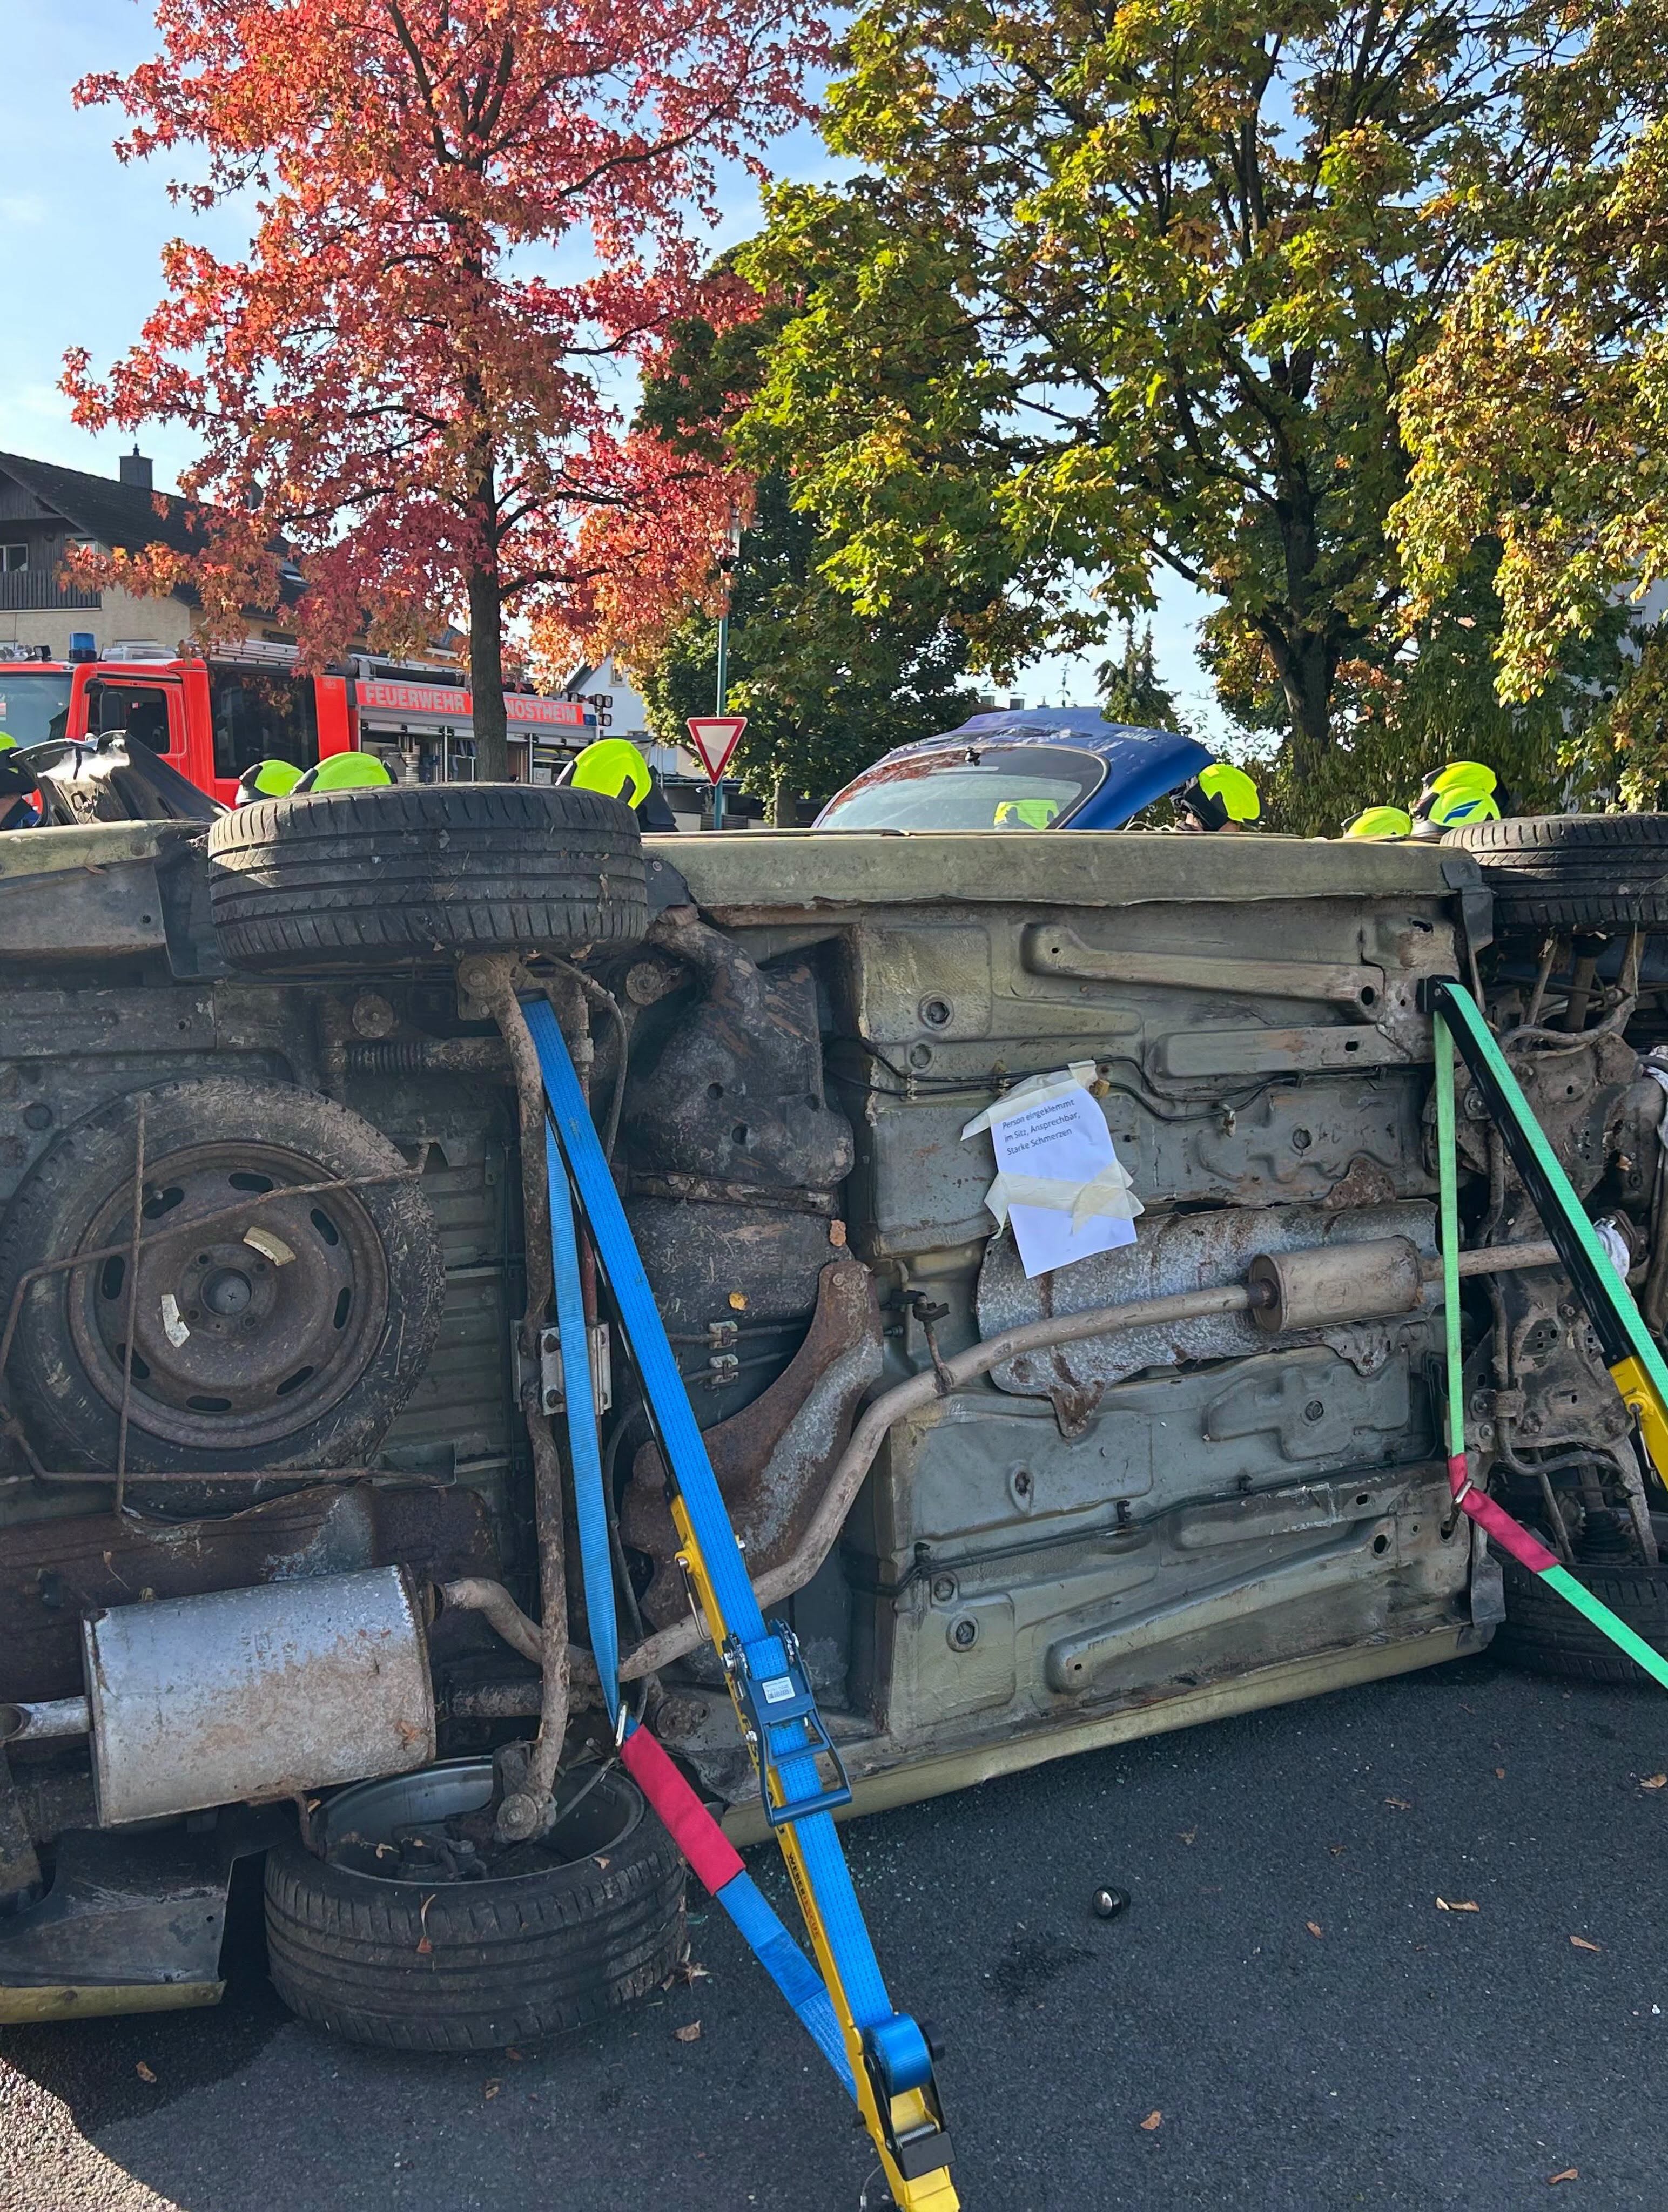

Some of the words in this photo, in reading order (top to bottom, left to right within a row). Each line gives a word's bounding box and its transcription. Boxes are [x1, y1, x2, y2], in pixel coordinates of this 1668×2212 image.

[365, 685, 465, 712] FEUERWEHR
[1002, 1116, 1025, 1130] Person
[1026, 1099, 1075, 1121] eingeklemmt
[1030, 1112, 1081, 1133] Ansprechbar,
[1007, 1141, 1030, 1156] Starke
[1030, 1128, 1072, 1147] Schmerzen
